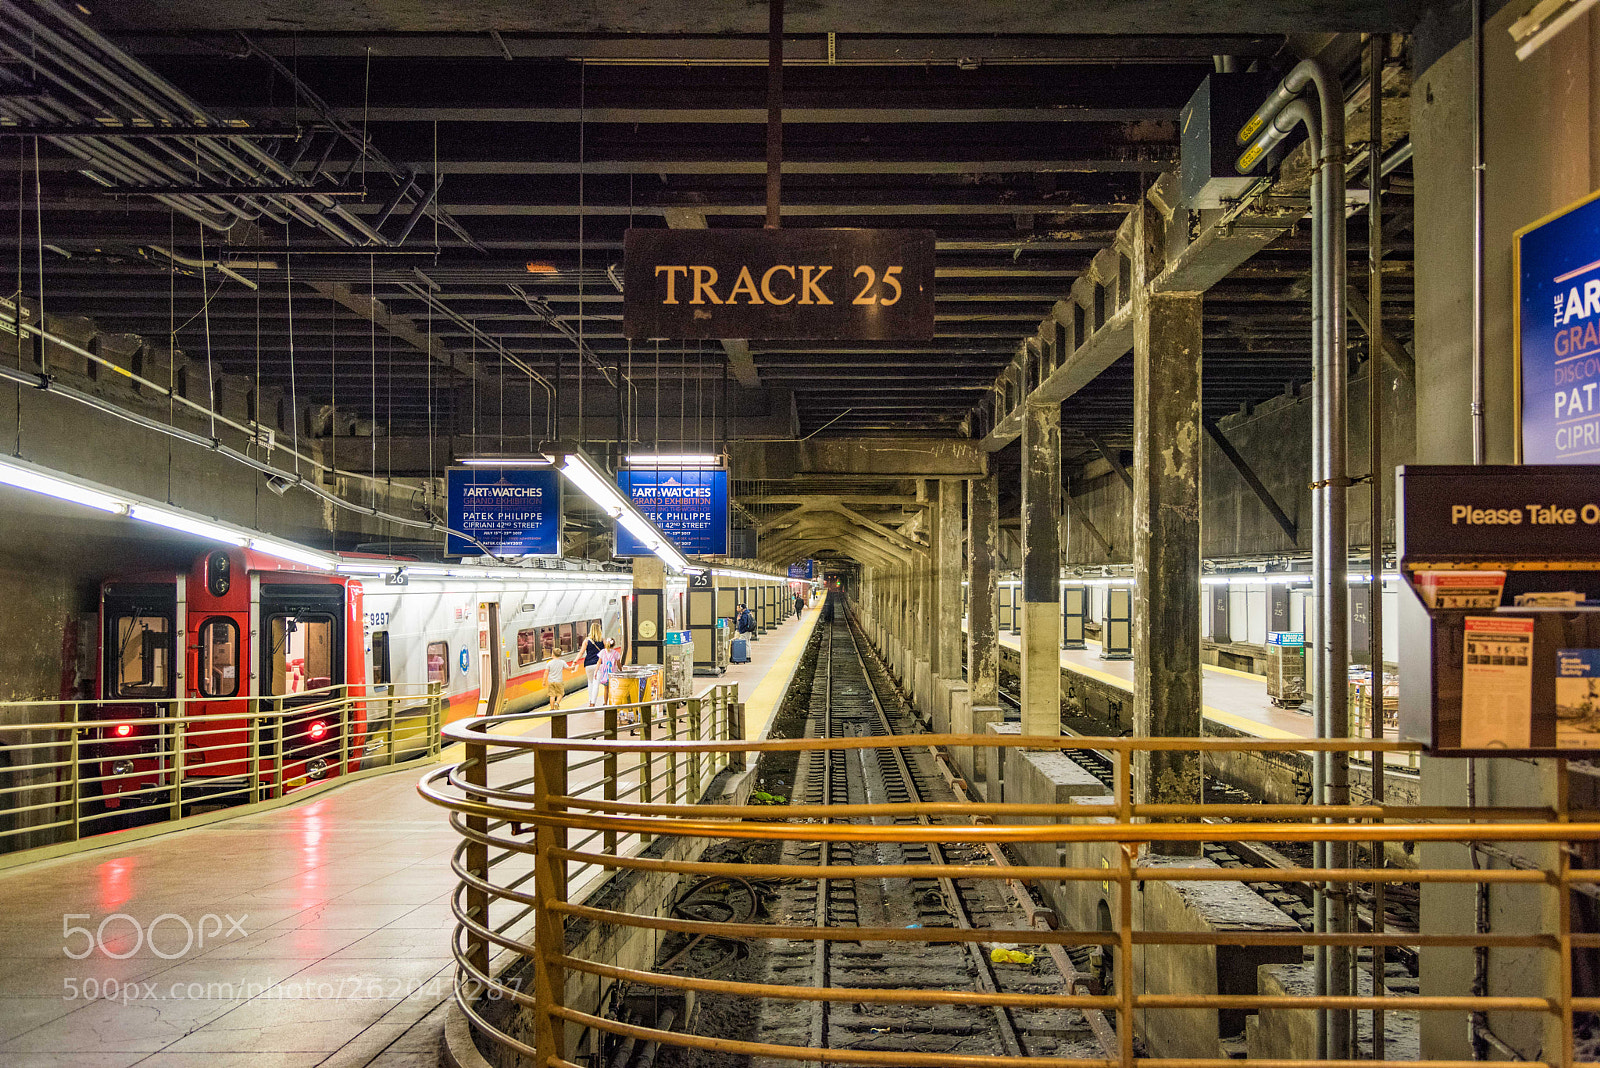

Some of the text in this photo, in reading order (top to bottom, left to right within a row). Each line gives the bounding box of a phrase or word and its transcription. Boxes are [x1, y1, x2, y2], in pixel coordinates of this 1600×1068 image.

[654, 264, 904, 306] TRACK 25
[1554, 293, 1564, 327] THE
[1554, 318, 1600, 357] GRA
[1554, 382, 1600, 418] PAT
[1555, 421, 1600, 451] CIPRI
[467, 487, 489, 497] ART
[492, 487, 543, 497] WATCHES
[636, 487, 658, 498] ART
[661, 487, 711, 498] WATCHES
[463, 497, 543, 505] GRAND EXHIBITION
[633, 497, 711, 505] GRAND EXHIBITION
[463, 512, 543, 520] PATEK PHILIPPE
[645, 512, 711, 520] TEK PHILIPPE
[1451, 503, 1600, 525] Please Take O
[463, 521, 495, 529] CIPRIANI
[390, 573, 404, 584] 26
[694, 575, 708, 586] 25
[1355, 602, 1363, 614] F
[370, 612, 390, 626] 9297
[1353, 613, 1367, 624] 24
